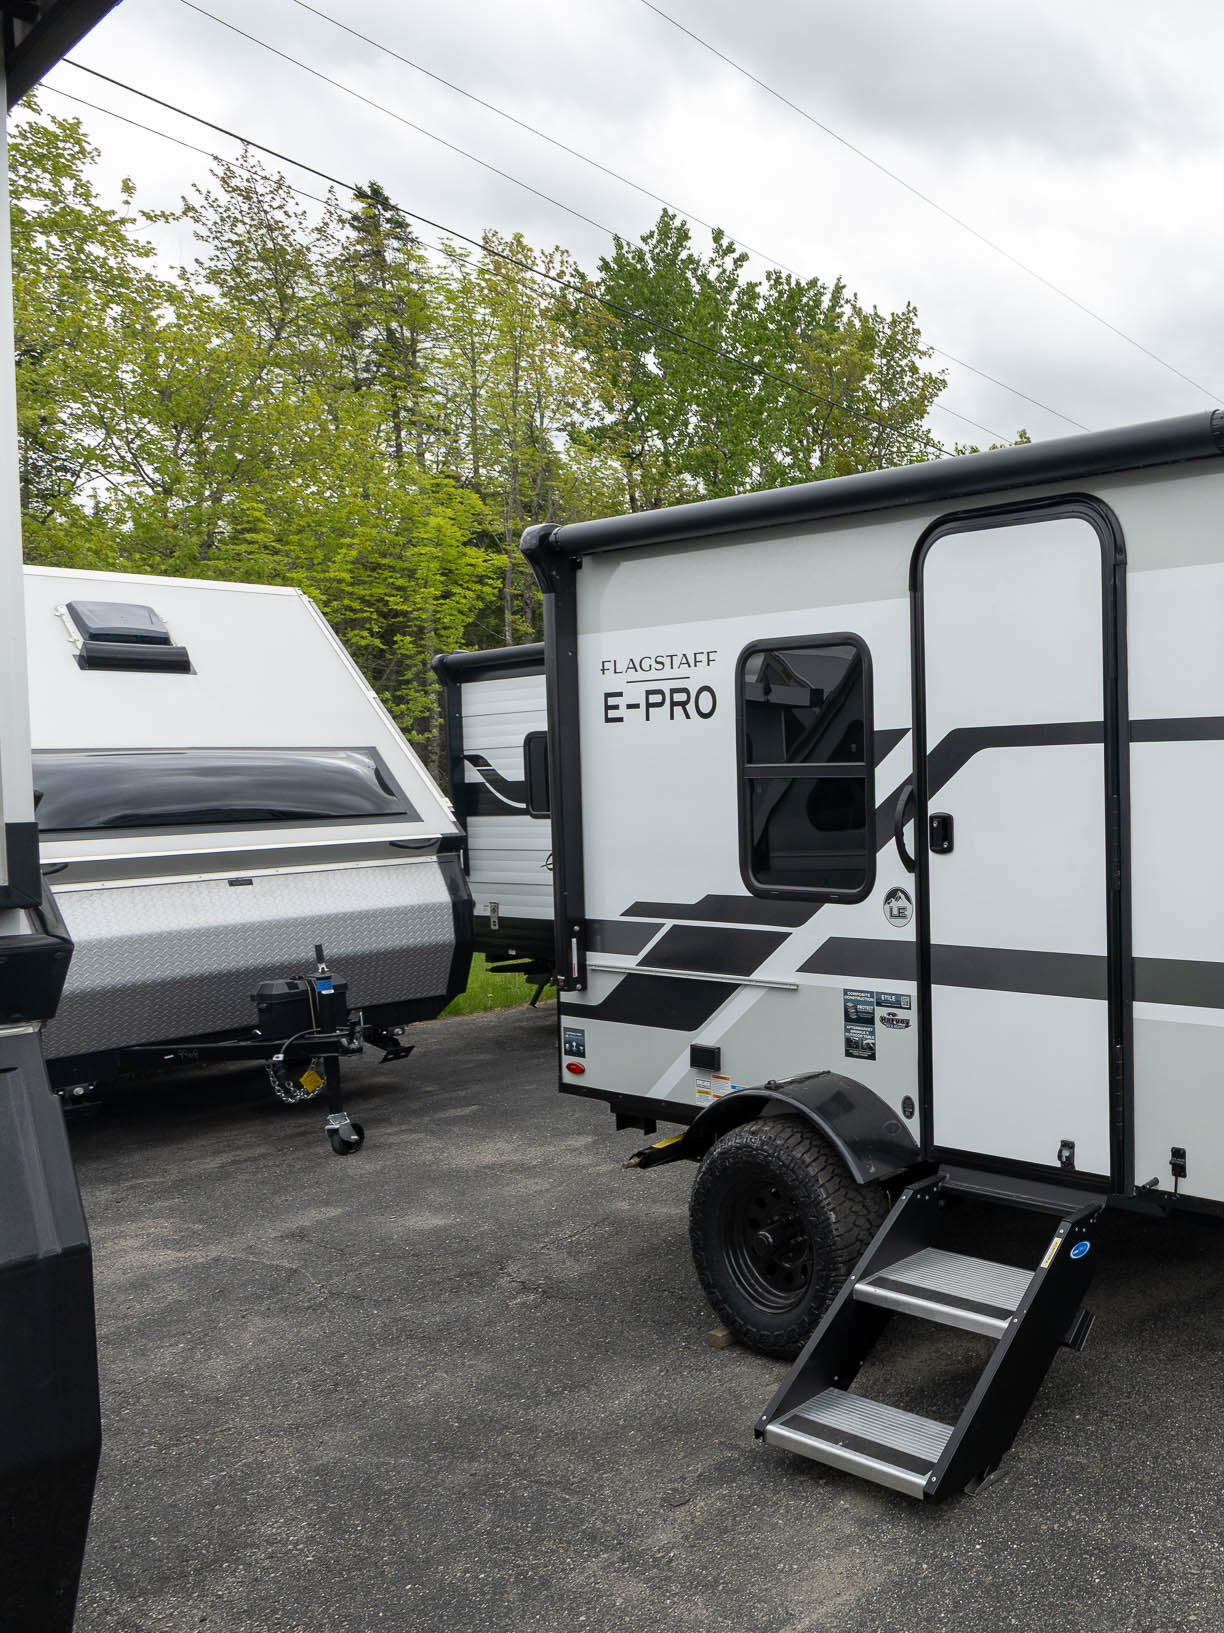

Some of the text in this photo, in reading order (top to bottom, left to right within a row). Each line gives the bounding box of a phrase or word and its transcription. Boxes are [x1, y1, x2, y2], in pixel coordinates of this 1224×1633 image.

[600, 650, 718, 675] FLAGSTAFF
[604, 685, 717, 723] E-PRO
[889, 905, 908, 919] LE
